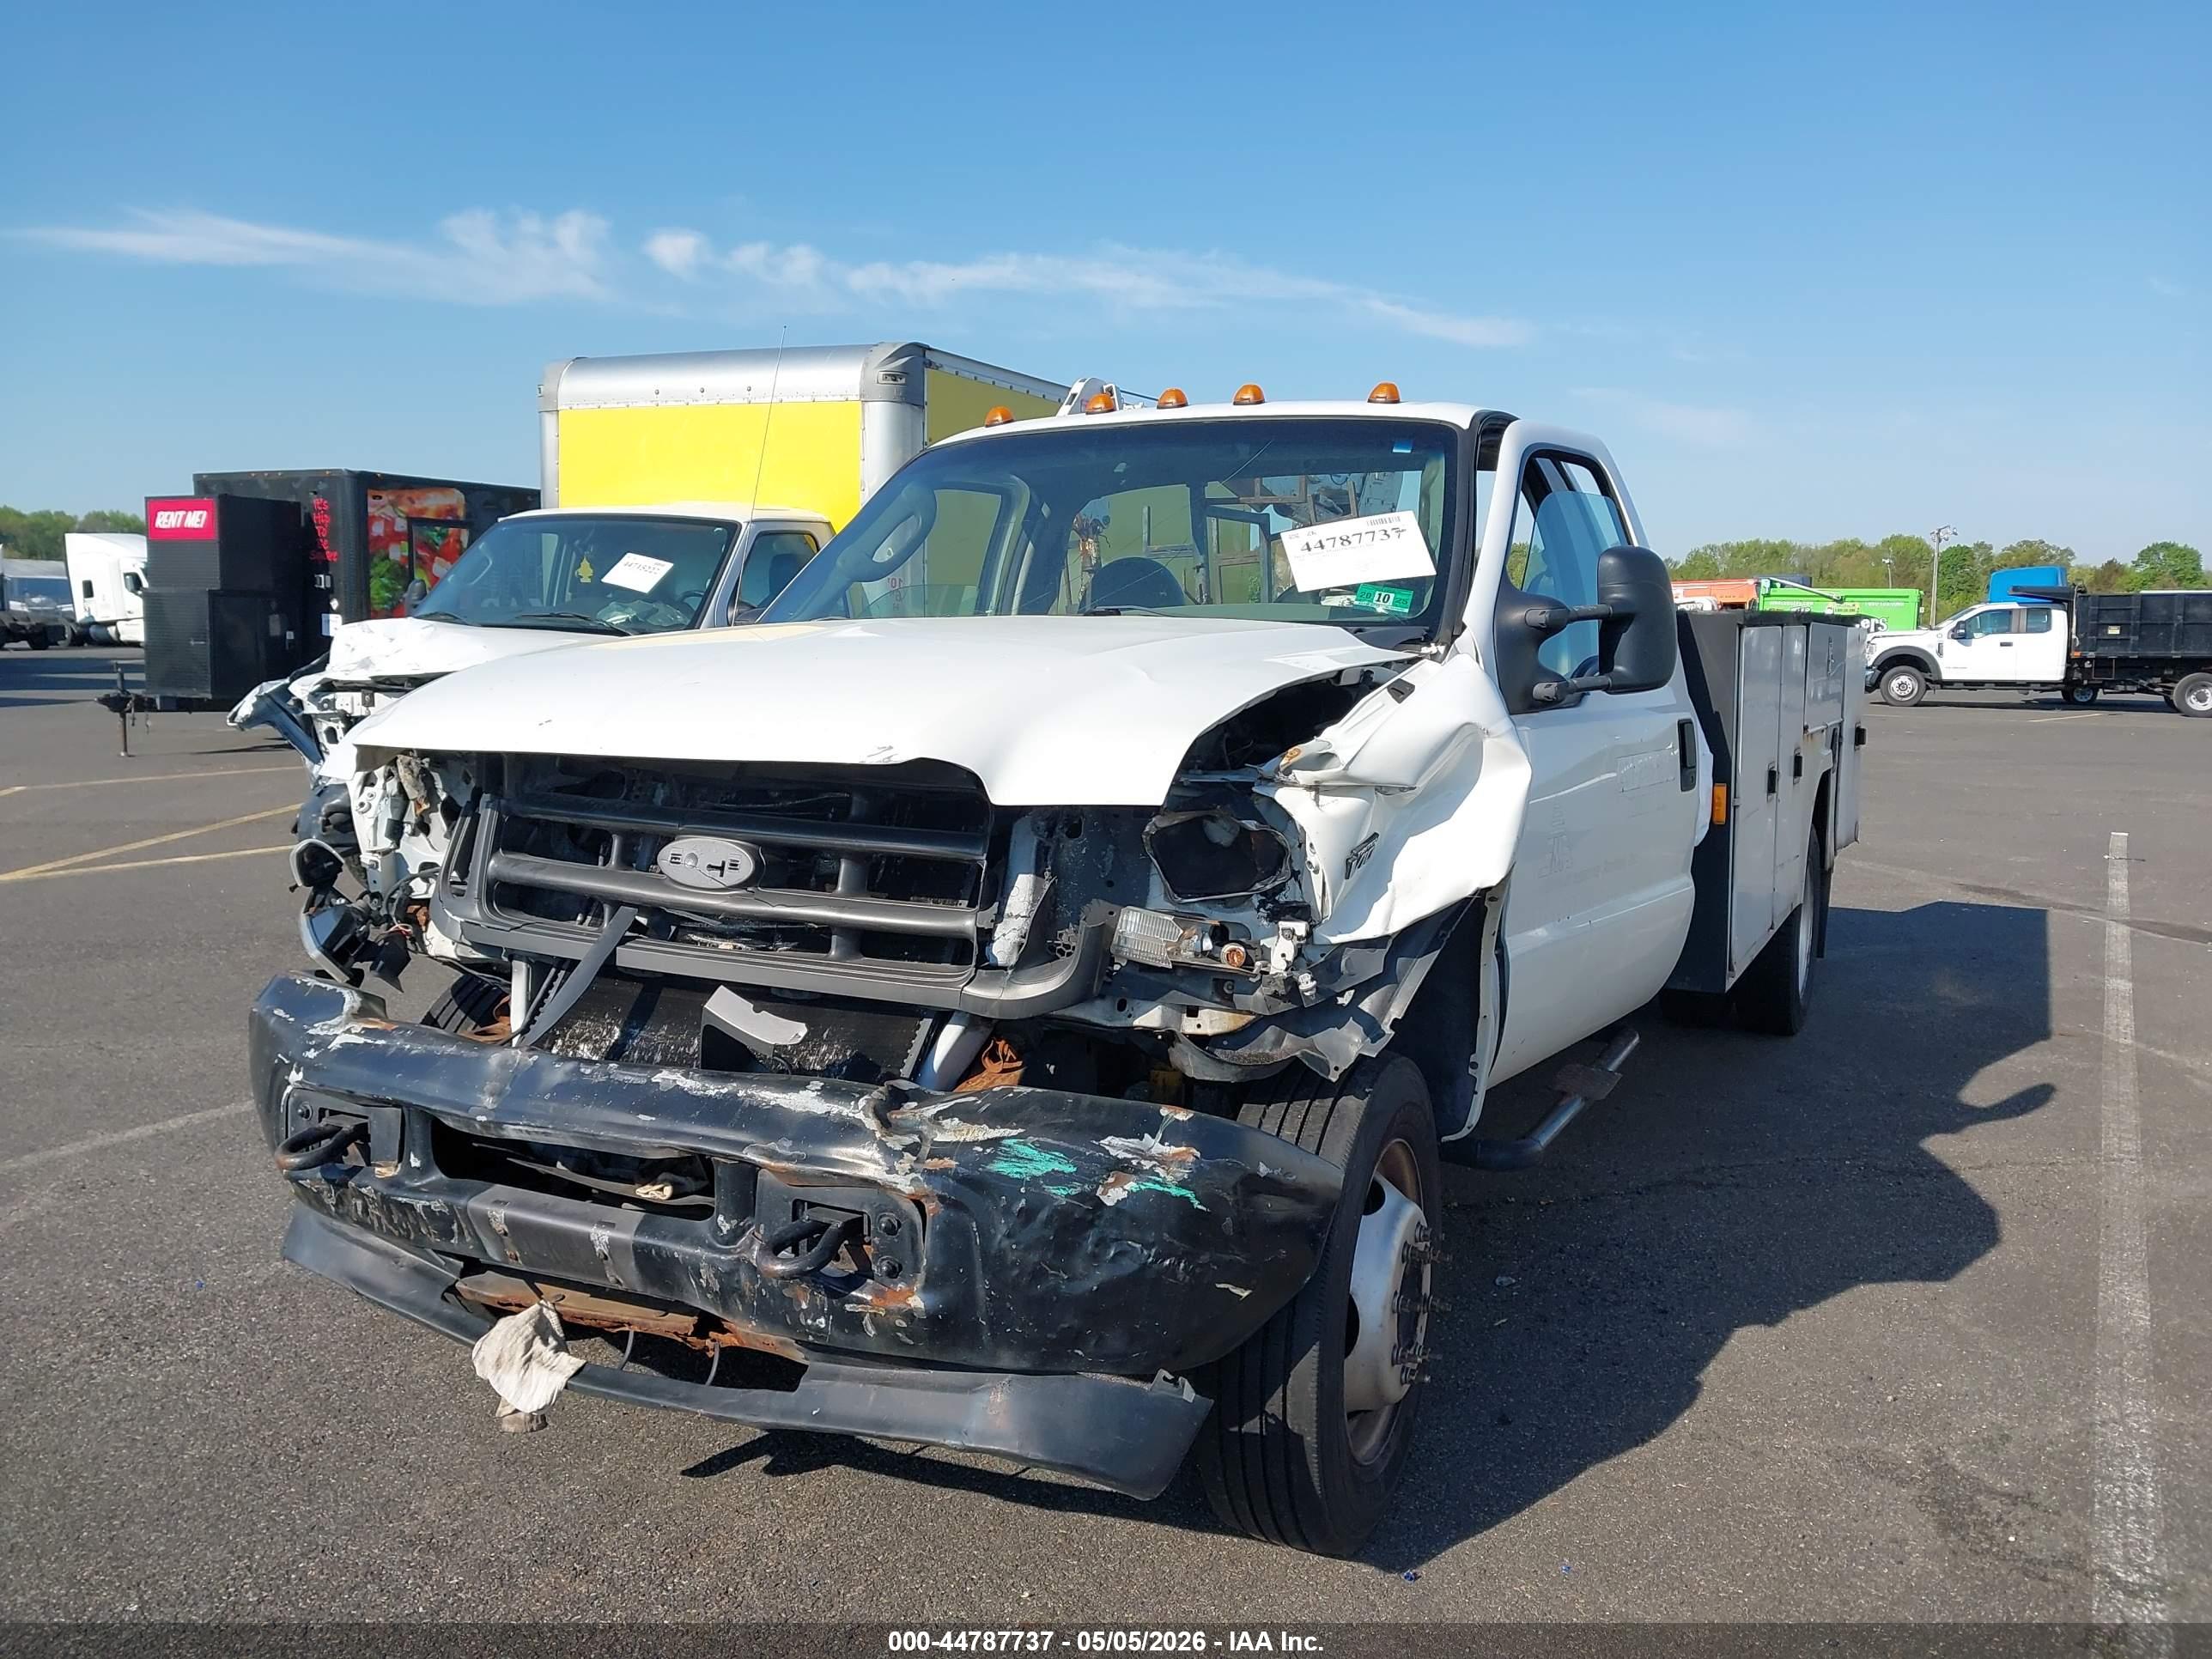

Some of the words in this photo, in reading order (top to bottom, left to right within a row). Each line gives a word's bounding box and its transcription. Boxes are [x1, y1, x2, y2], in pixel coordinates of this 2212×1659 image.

[155, 510, 186, 528] RENT
[184, 510, 207, 528] ME!
[1300, 526, 1407, 552] 44787737
[1359, 591, 1372, 599] 20
[1375, 592, 1391, 604] 10
